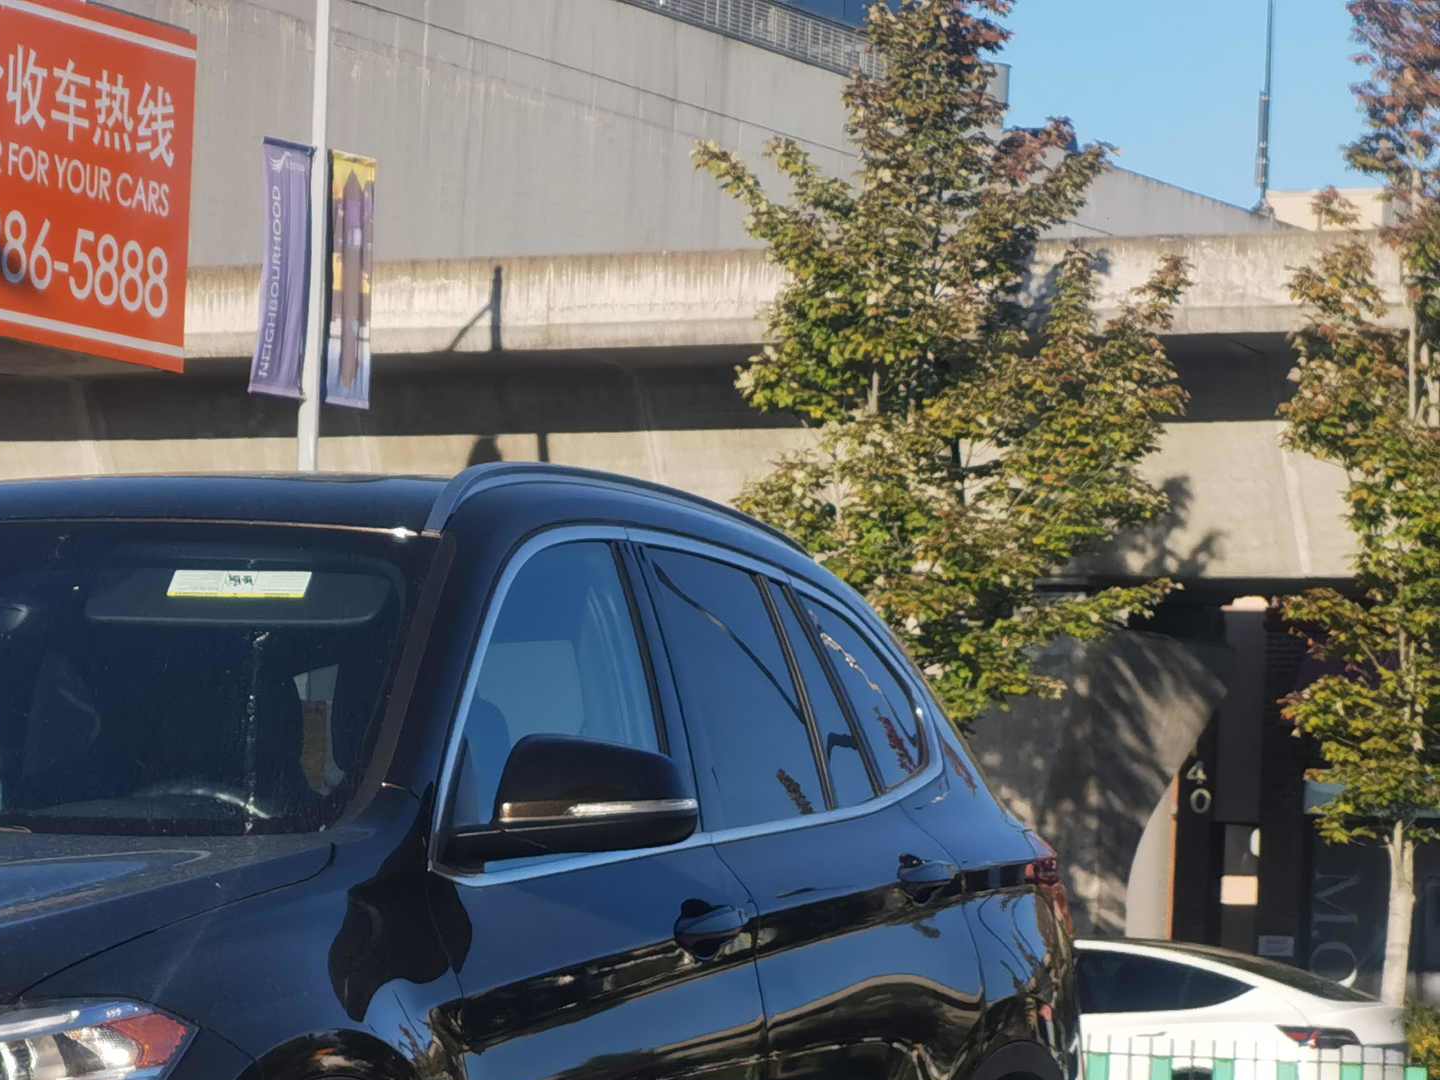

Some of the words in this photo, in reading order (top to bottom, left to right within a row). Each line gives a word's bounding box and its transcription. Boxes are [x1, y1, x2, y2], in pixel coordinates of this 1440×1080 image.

[9, 142, 49, 187] FOR
[54, 154, 111, 202] YOUR
[116, 173, 170, 217] CARS
[259, 185, 283, 377] NEIGHBOURHOOD
